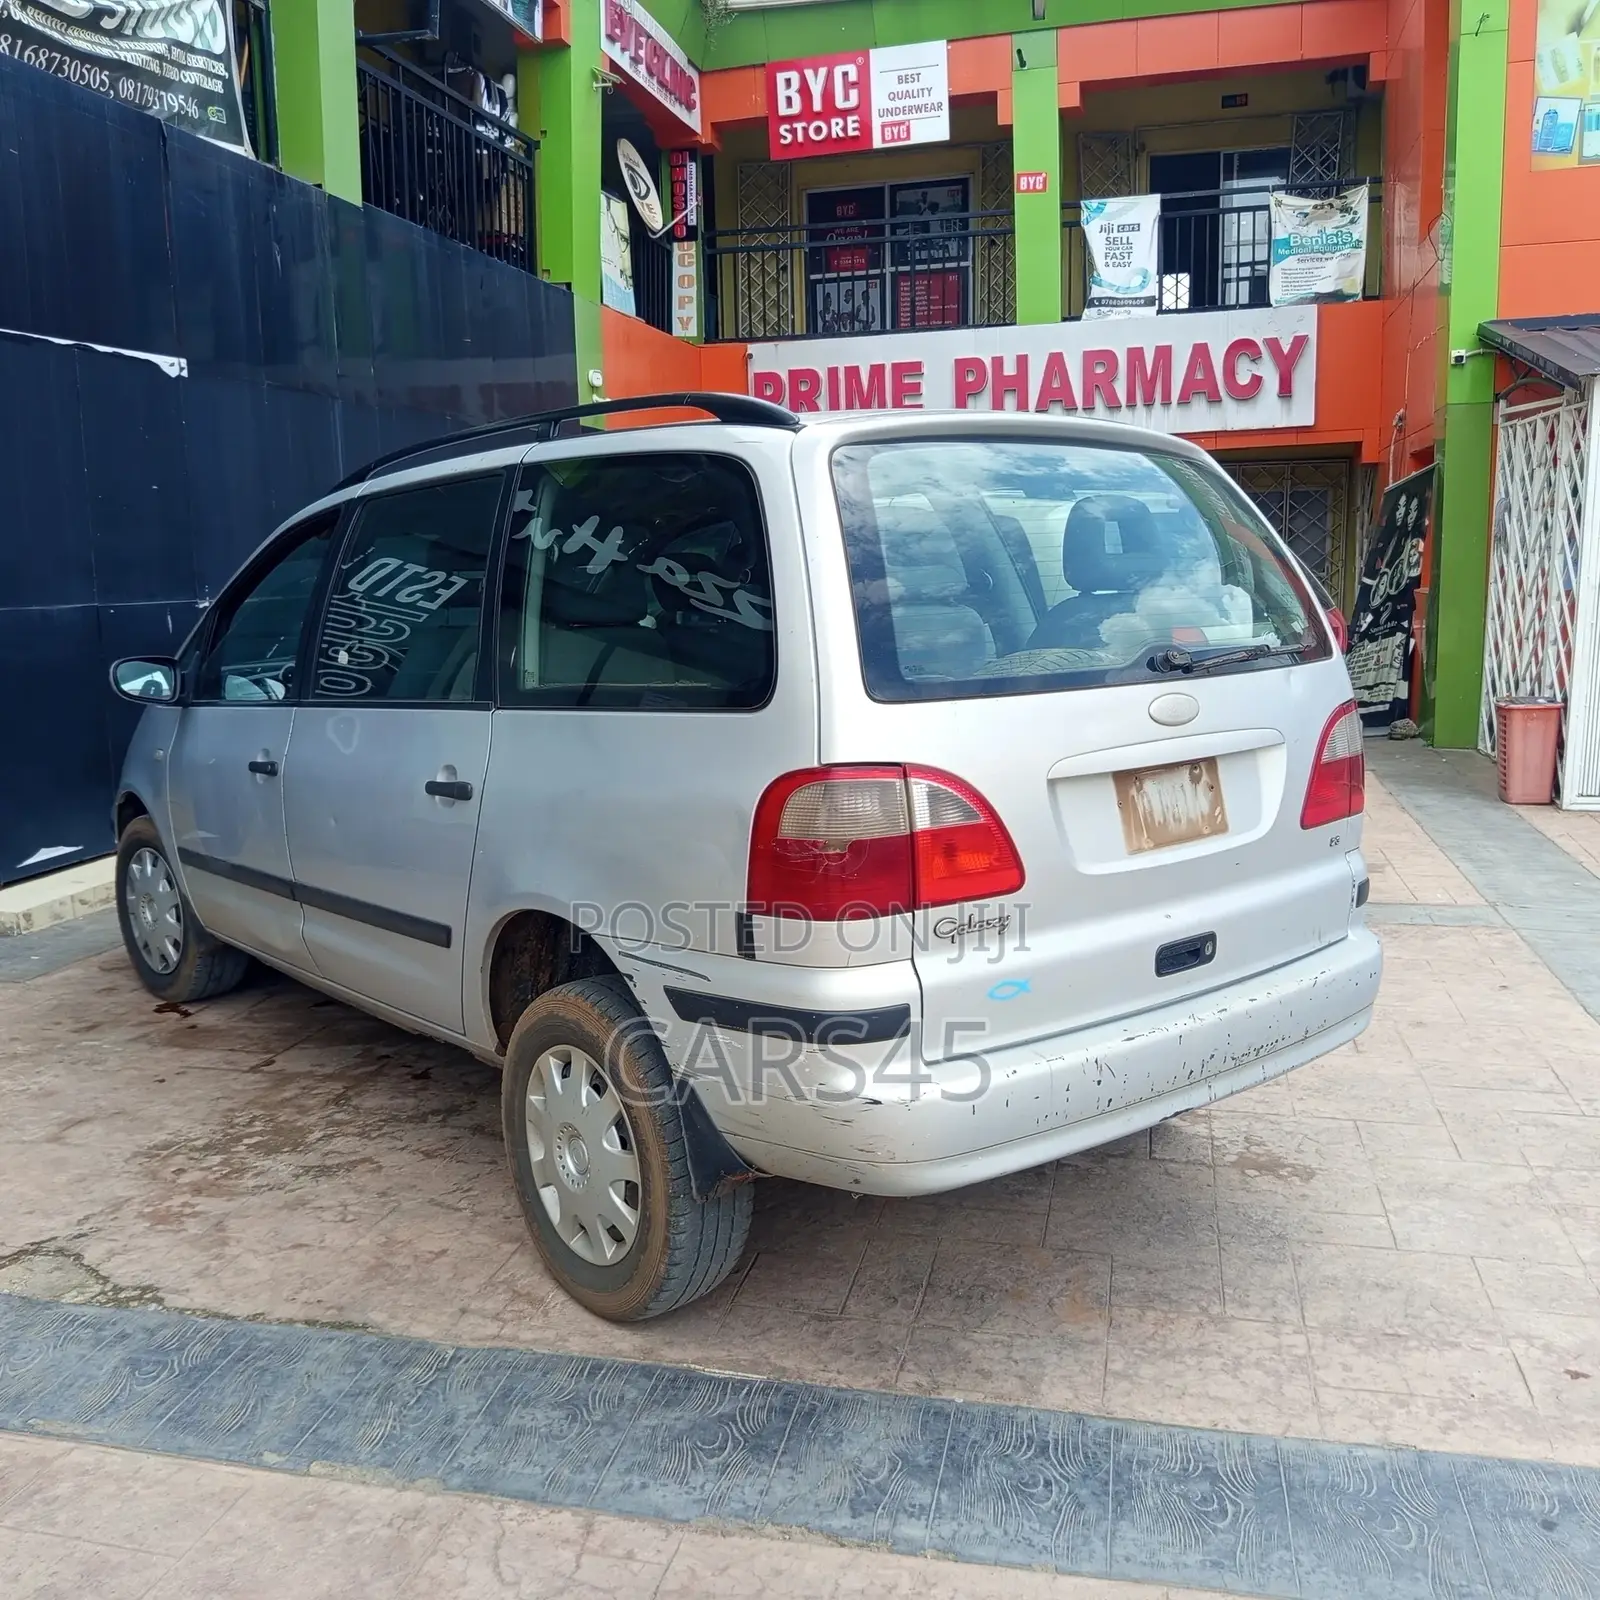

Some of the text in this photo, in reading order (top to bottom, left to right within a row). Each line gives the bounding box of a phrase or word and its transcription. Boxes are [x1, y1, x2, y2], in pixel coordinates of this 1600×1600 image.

[180, 70, 224, 94] COVERAGE
[897, 72, 922, 85] BEST
[118, 77, 200, 120] 08179379546
[776, 63, 861, 117] BYC
[888, 87, 934, 102] QUALITY
[878, 101, 944, 119] UNDERWEAR
[779, 115, 861, 146] STORE
[883, 124, 908, 141] BYC
[1019, 175, 1044, 191] BYC
[1099, 223, 1139, 235] Jiji cars
[1105, 236, 1133, 246] SELL
[1104, 251, 1133, 261] FAST
[753, 334, 1309, 412] PRIME PHARMACY
[933, 913, 1011, 944] Galaxy
